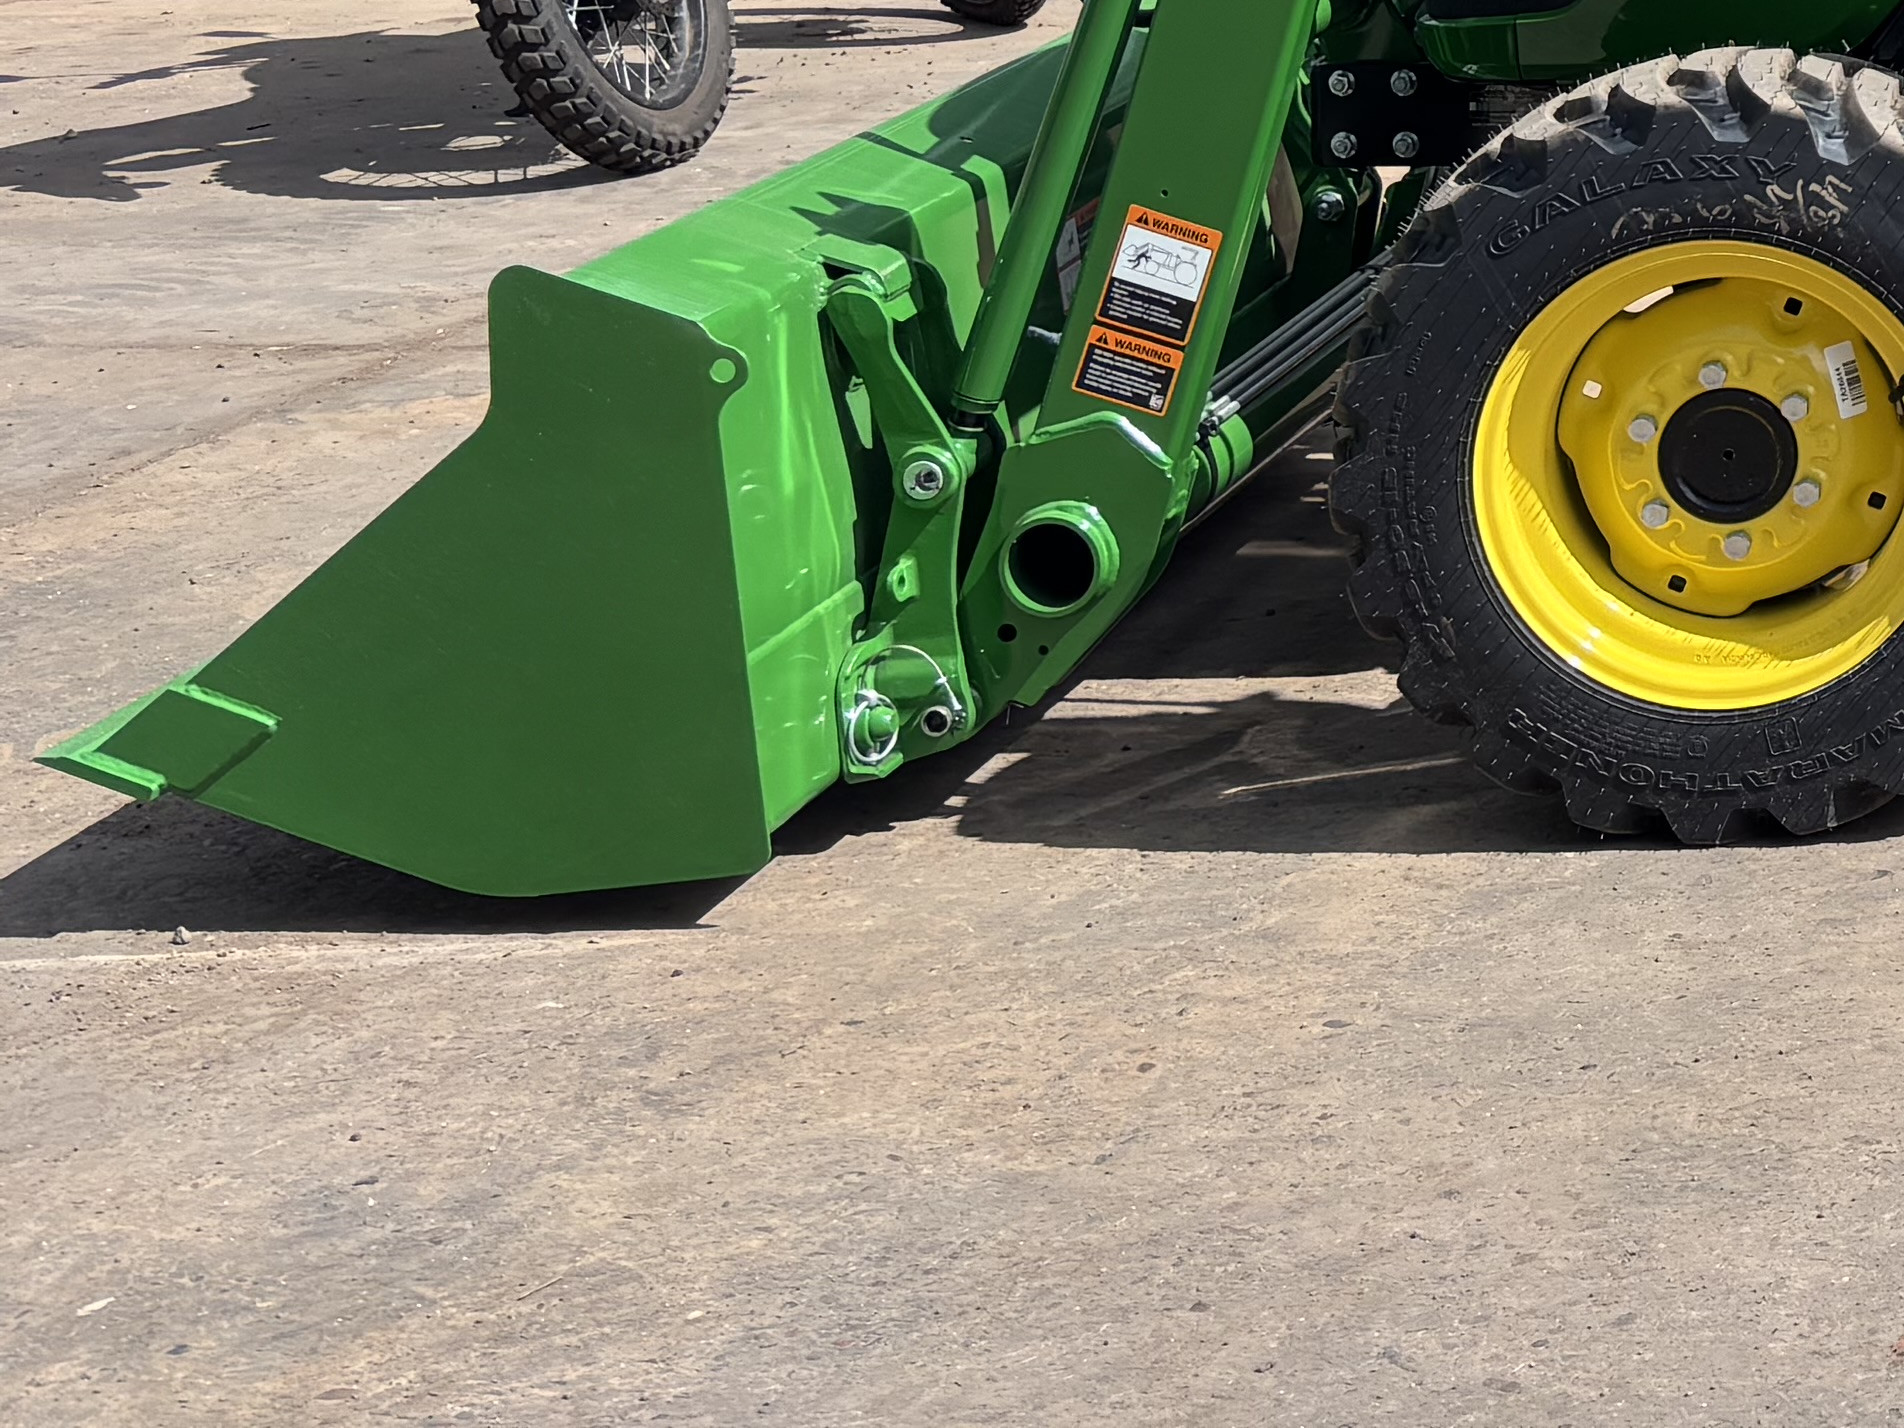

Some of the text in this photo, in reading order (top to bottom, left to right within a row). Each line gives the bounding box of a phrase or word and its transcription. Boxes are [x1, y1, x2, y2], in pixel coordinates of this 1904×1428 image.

[1488, 153, 1798, 256] GALAXY
[1151, 217, 1210, 245] WARNING
[1114, 336, 1173, 364] WARNING
